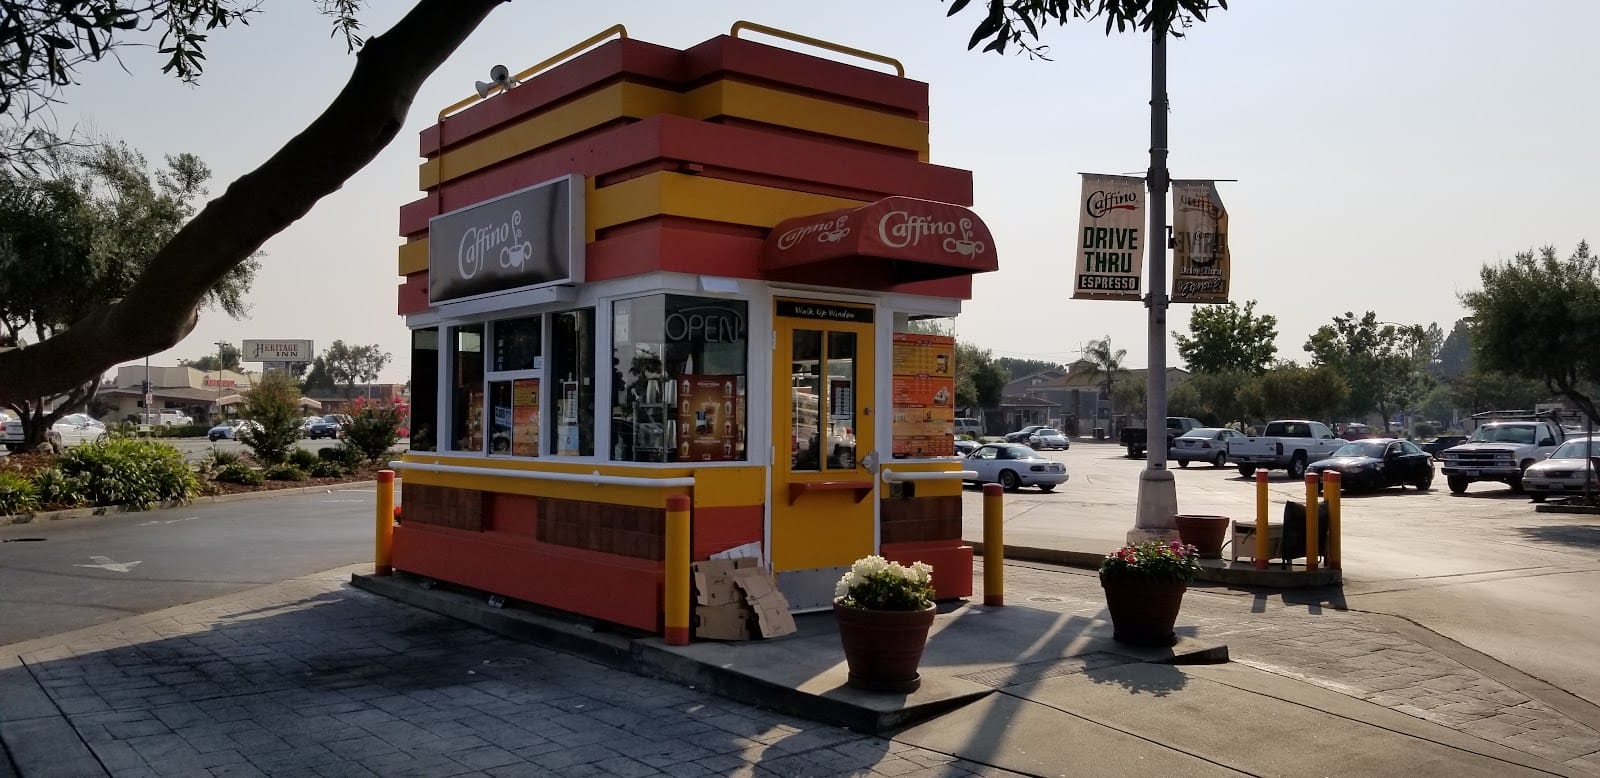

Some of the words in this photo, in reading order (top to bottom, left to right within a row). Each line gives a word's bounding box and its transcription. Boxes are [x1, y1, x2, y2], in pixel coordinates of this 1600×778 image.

[1086, 190, 1137, 218] Caffino
[777, 220, 833, 250] Caffino
[878, 211, 956, 248] Caffino
[1083, 226, 1138, 250] DRIVE
[458, 222, 509, 280] Caffino
[1084, 251, 1132, 274] THRU
[1081, 276, 1136, 290] ESPRESSO
[794, 305, 814, 316] Walk
[816, 307, 827, 318] Up
[828, 308, 856, 319] Window
[665, 313, 739, 343] OPEN
[254, 343, 299, 357] HERITAGE
